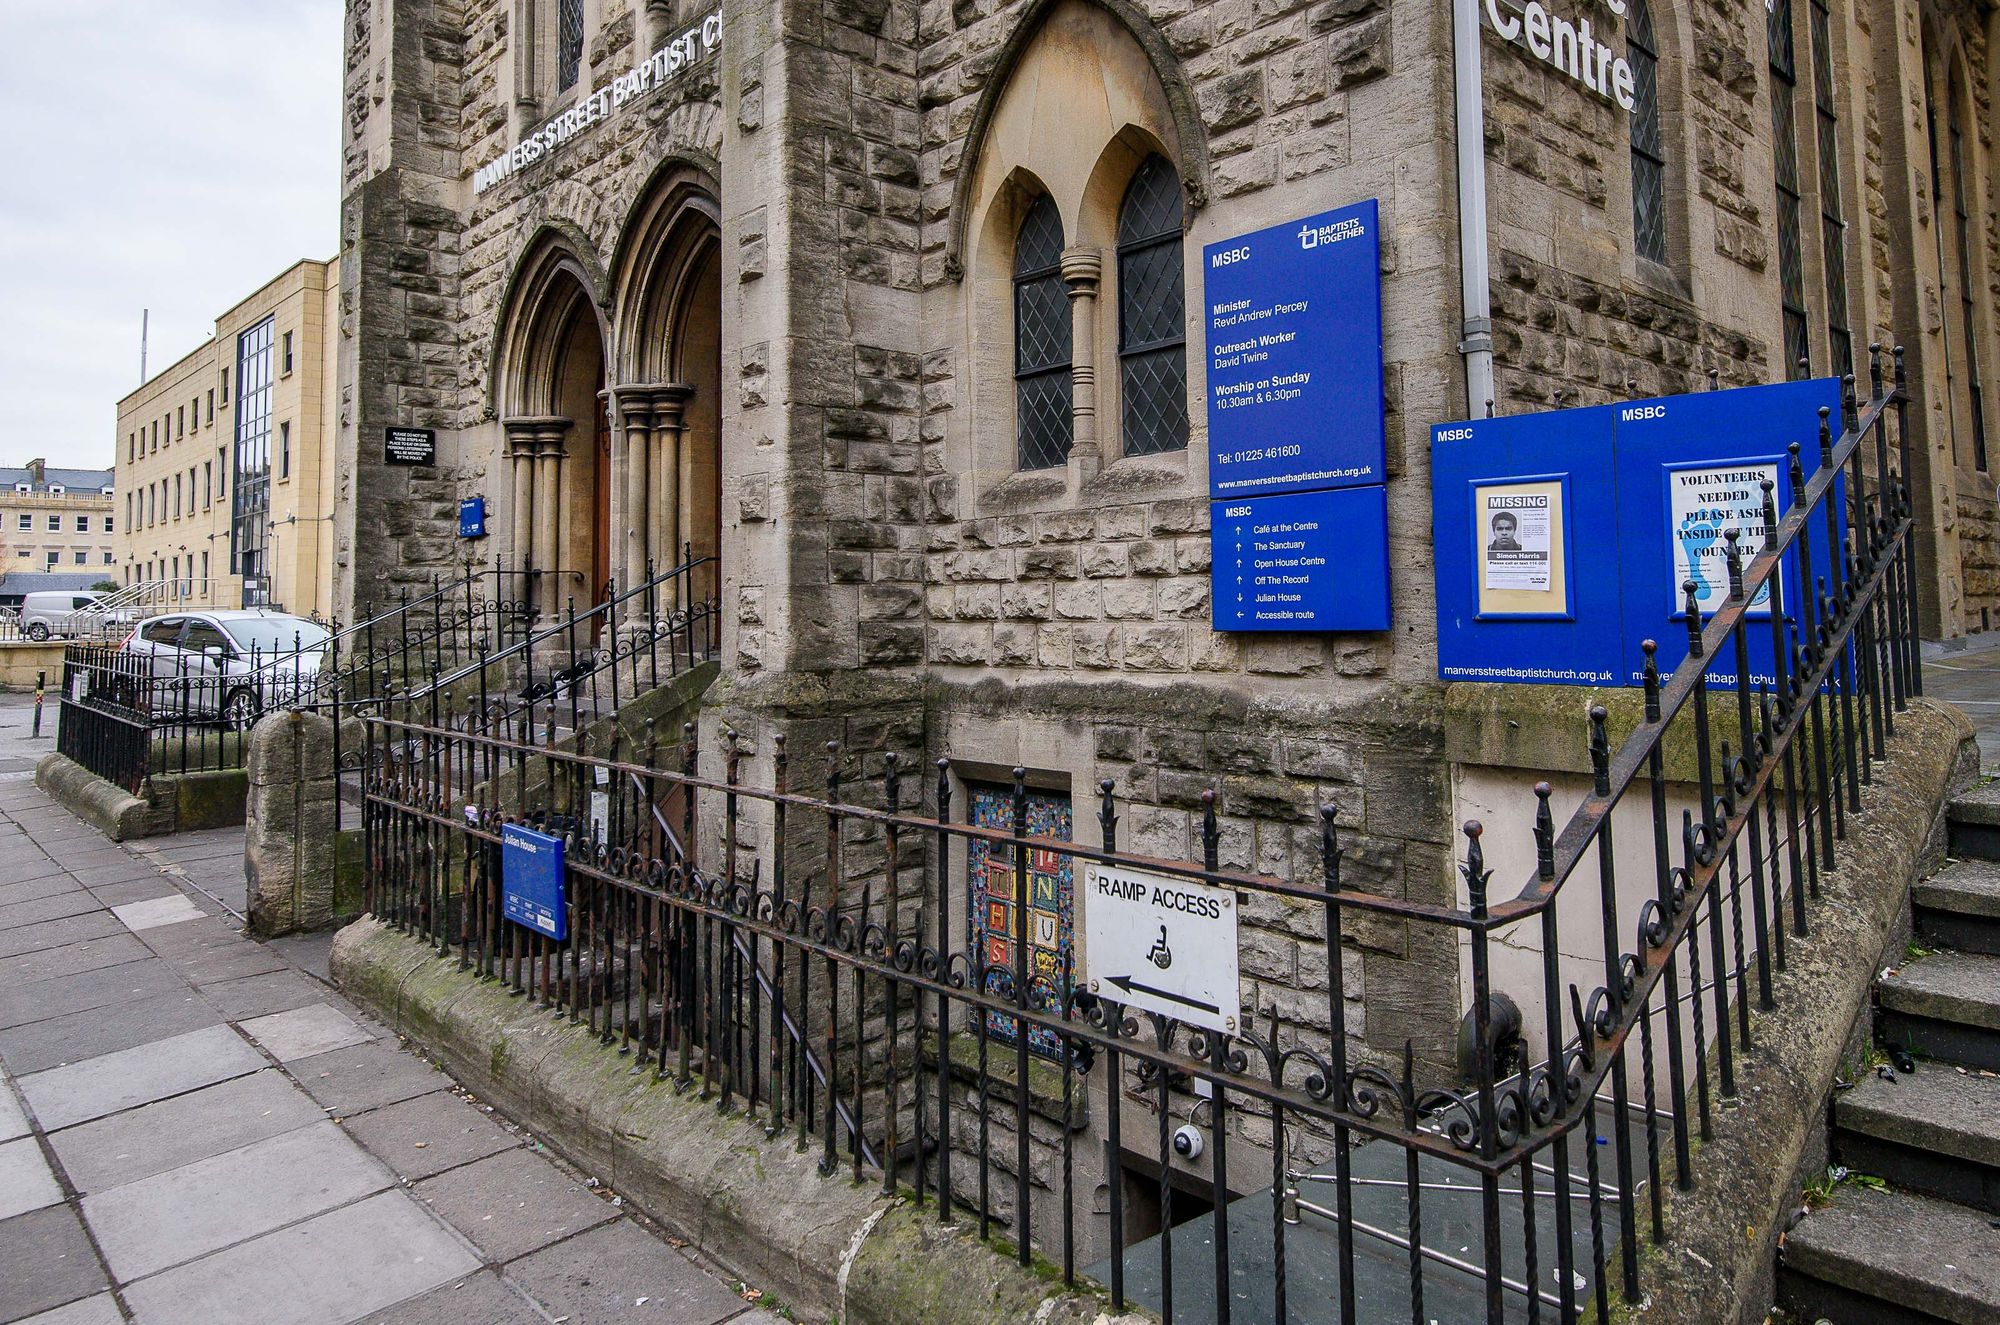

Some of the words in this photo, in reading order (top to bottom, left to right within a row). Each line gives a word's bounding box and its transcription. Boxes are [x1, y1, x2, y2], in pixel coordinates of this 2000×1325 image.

[473, 132, 545, 196] MANVERS
[545, 86, 612, 150] STREET
[613, 28, 700, 110] BAPTIST
[1319, 218, 1360, 236] BAPTISTS
[1319, 226, 1365, 246] TOGETHER
[1212, 246, 1250, 268] MSBC
[1214, 299, 1251, 315] Minister
[1214, 314, 1236, 328] Revd
[1238, 307, 1272, 324] Andrew
[1275, 300, 1309, 317] Percey
[1215, 339, 1257, 355] Outreach
[1259, 331, 1296, 347] Worker
[1215, 355, 1240, 370] David
[1242, 350, 1268, 364] Twine
[1215, 380, 1255, 397] Worship
[1257, 379, 1270, 390] on
[1272, 371, 1311, 387] Sunday
[1216, 394, 1254, 410] 10.30am
[1256, 392, 1264, 404] &
[1265, 387, 1301, 403] 6.30pm
[1622, 405, 1666, 422] MSBC
[1437, 428, 1473, 442] MSBC
[1218, 453, 1233, 464] Tel:
[1235, 449, 1263, 463] 01225
[1265, 444, 1301, 459] 461600
[1218, 465, 1372, 489] www.manversstreetbaptistchurch.org.uk
[1681, 471, 1765, 486] VOLUNTEERS
[1490, 496, 1546, 508] MISSING
[1698, 490, 1749, 503] NEEDED
[1225, 506, 1252, 518] MSBC
[1686, 509, 1734, 522] PLEASE
[1254, 524, 1270, 534] Café
[1271, 525, 1279, 533] at
[1280, 523, 1292, 532] the
[1293, 522, 1318, 531] Centre
[1678, 528, 1722, 540] INSIDE
[1254, 542, 1268, 551] The
[1269, 540, 1305, 551] Sanctuary
[1254, 559, 1274, 570] Open
[1275, 558, 1298, 568] House
[1300, 557, 1325, 566] Centre
[1255, 576, 1266, 585] Off
[1267, 576, 1281, 585] The
[1283, 575, 1309, 584] Record
[1256, 594, 1276, 602] Julian
[1277, 593, 1301, 602] House
[1256, 611, 1294, 619] Accessible
[1295, 611, 1315, 619] route
[1444, 665, 1612, 682] manversstreetbaptistchurch.org.uk
[505, 833, 520, 848] Julian
[520, 838, 537, 853] House
[1098, 875, 1147, 903] RAMP
[1151, 887, 1220, 919] ACCESS
